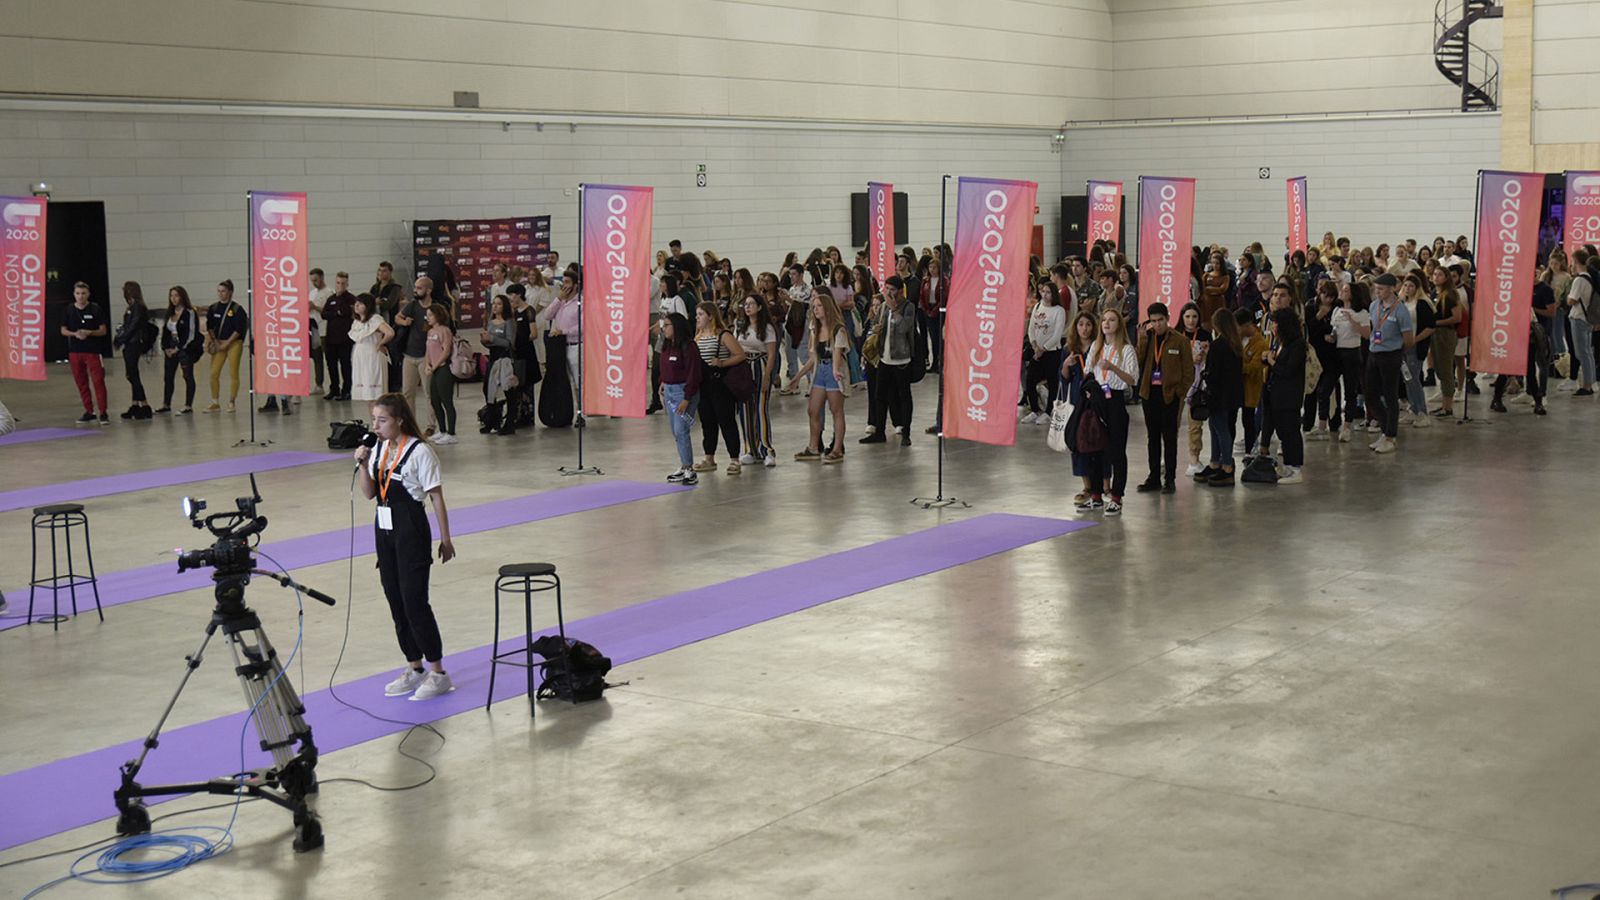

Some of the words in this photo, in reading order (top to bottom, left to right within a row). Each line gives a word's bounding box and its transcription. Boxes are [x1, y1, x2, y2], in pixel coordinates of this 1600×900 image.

[6, 228, 40, 241] 2020
[262, 228, 297, 241] 2020
[1093, 203, 1115, 212] 2020
[1156, 184, 1177, 313] Casting2020
[1491, 179, 1522, 358] #OTCasting2020
[4, 254, 20, 364] OPERACIÓN
[22, 254, 41, 366] TRIUNFO
[260, 256, 281, 378] OPERACIÓN
[279, 256, 302, 379] TRIUNFO
[606, 194, 629, 399] #OTCasting2020
[966, 189, 1008, 422] #OTCasting2020
